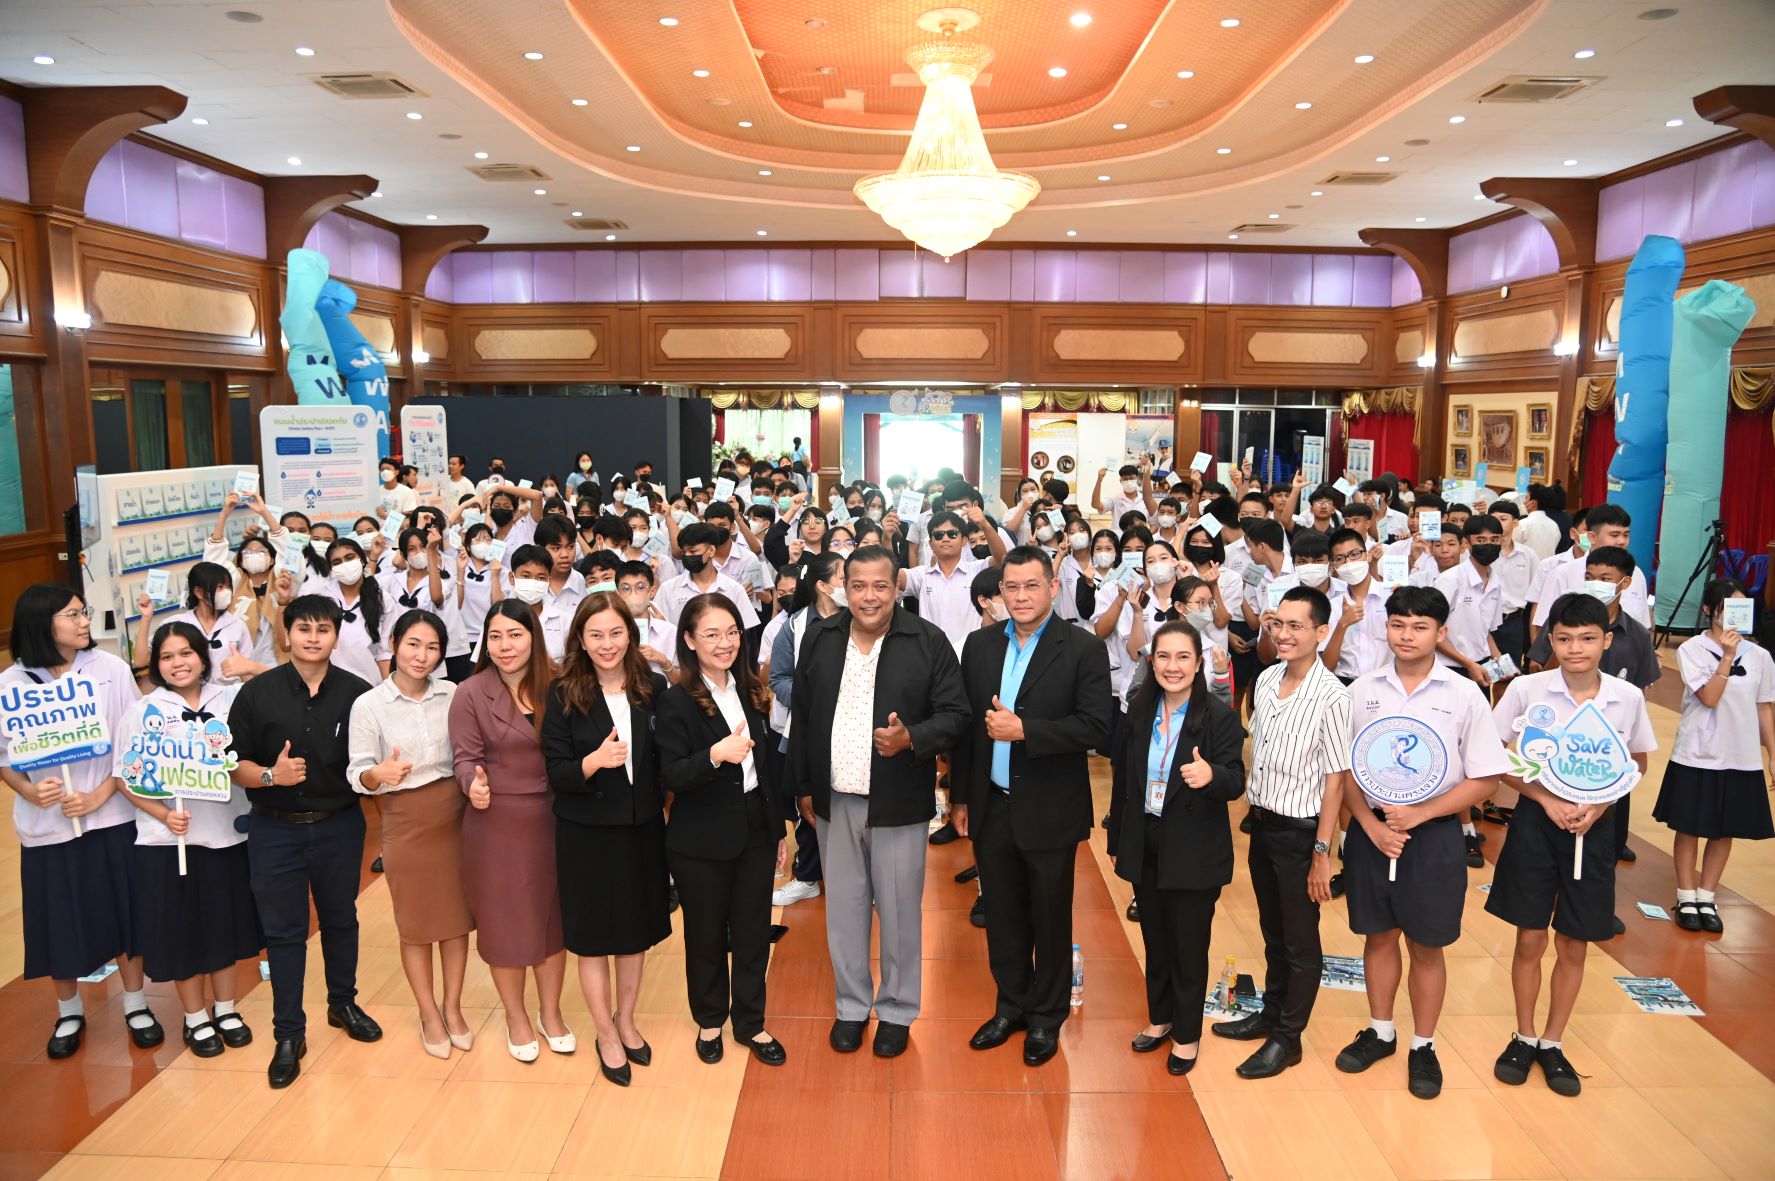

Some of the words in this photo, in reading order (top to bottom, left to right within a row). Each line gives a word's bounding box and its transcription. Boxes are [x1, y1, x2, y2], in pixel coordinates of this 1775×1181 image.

[1, 677, 94, 712] ประปา
[6, 702, 96, 737] คุณภาพ
[13, 721, 103, 754] เพื่อชีวิตที่ดี
[131, 723, 206, 760] ยอดน้ำ
[18, 762, 38, 771] Quality
[37, 759, 53, 767] Water
[60, 755, 77, 763] Quality
[77, 751, 93, 759] Living
[1359, 769, 1438, 799] การประปานครหลวง
